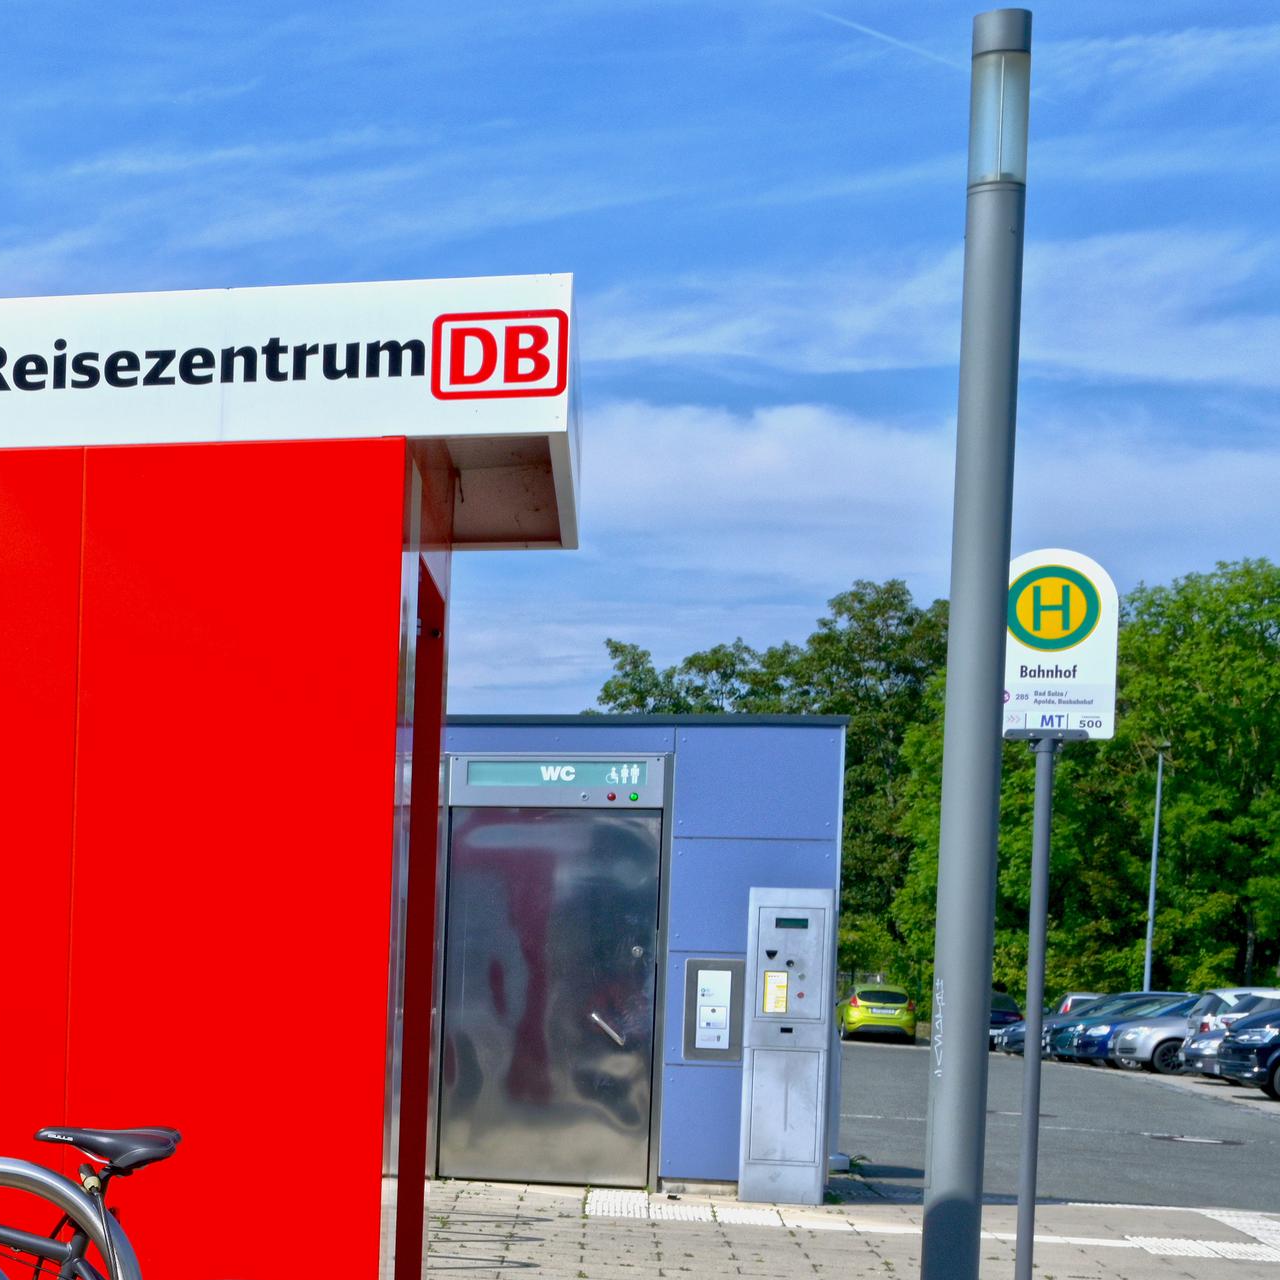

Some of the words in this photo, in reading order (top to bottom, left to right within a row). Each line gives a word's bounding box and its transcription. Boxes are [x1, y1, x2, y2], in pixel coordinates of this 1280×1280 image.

[449, 325, 551, 384] DB
[1019, 664, 1077, 679] Bahnhof
[1040, 714, 1065, 728] MT
[1079, 719, 1102, 728] 500
[540, 765, 576, 781] WC
